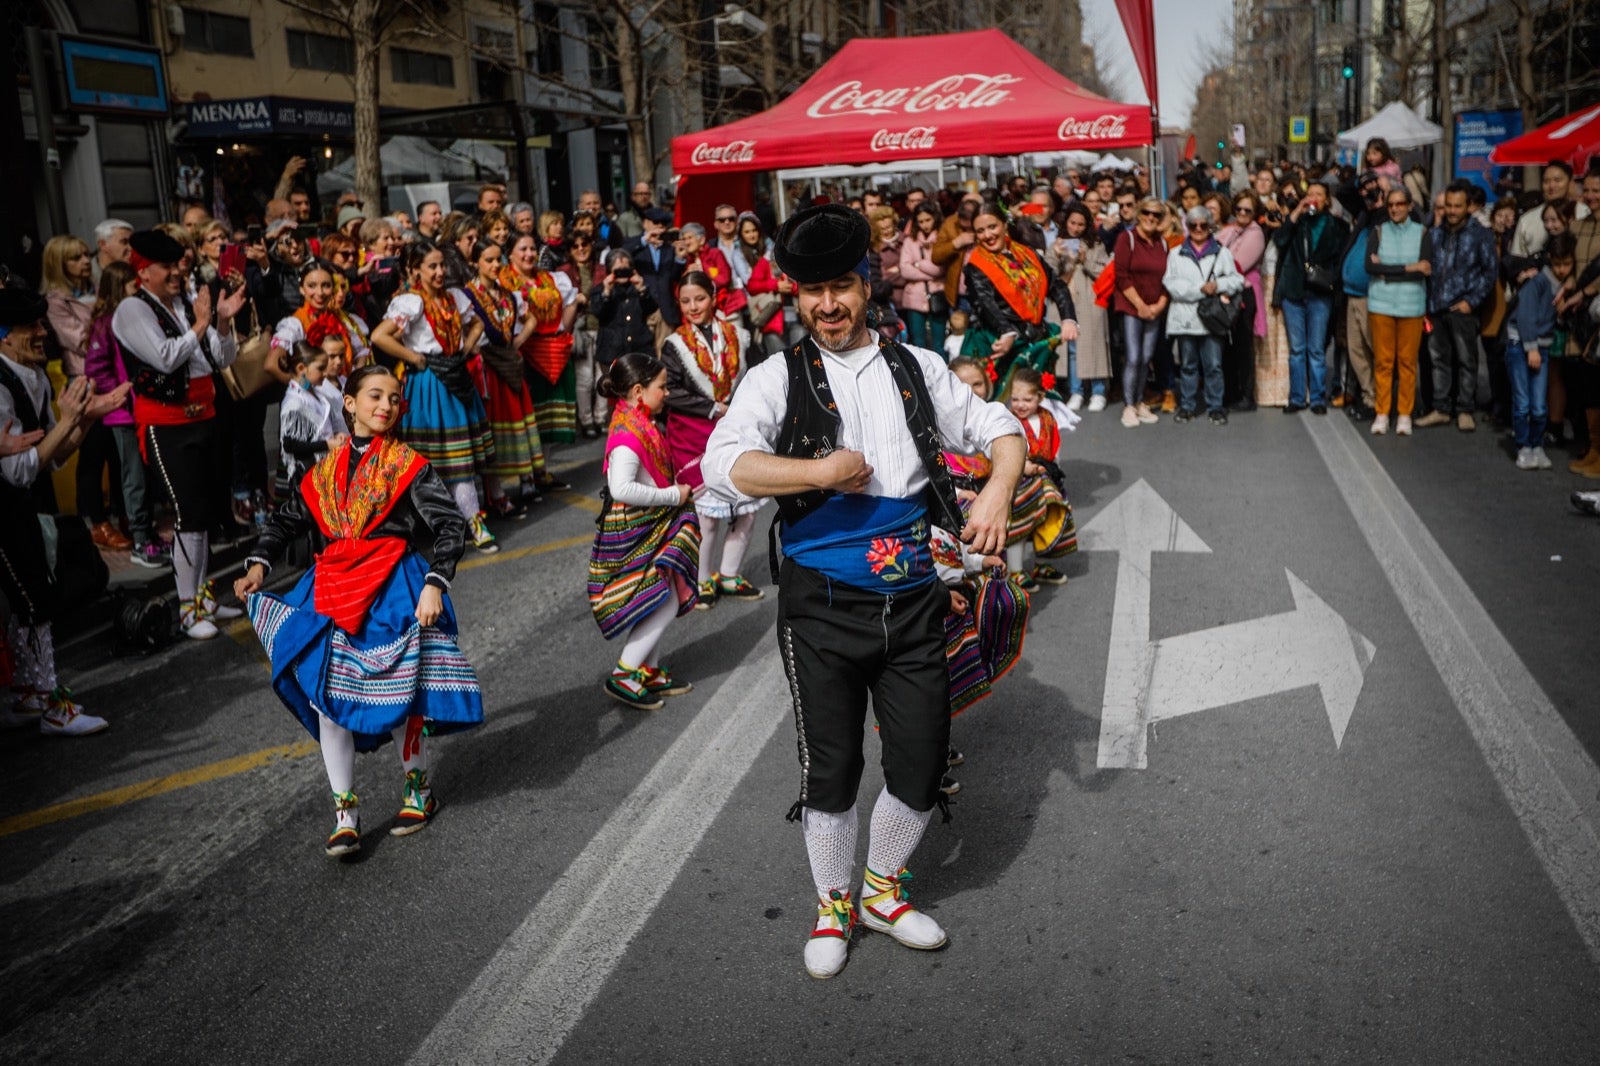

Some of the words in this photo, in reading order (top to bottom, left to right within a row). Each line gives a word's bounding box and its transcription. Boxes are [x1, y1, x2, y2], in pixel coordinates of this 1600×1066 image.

[806, 73, 1023, 118] Coca-Cola
[191, 101, 270, 123] MENARA
[870, 126, 938, 152] Coca-Cola
[1057, 114, 1128, 141] Coca-Cola
[691, 140, 757, 165] Coca-Cola
